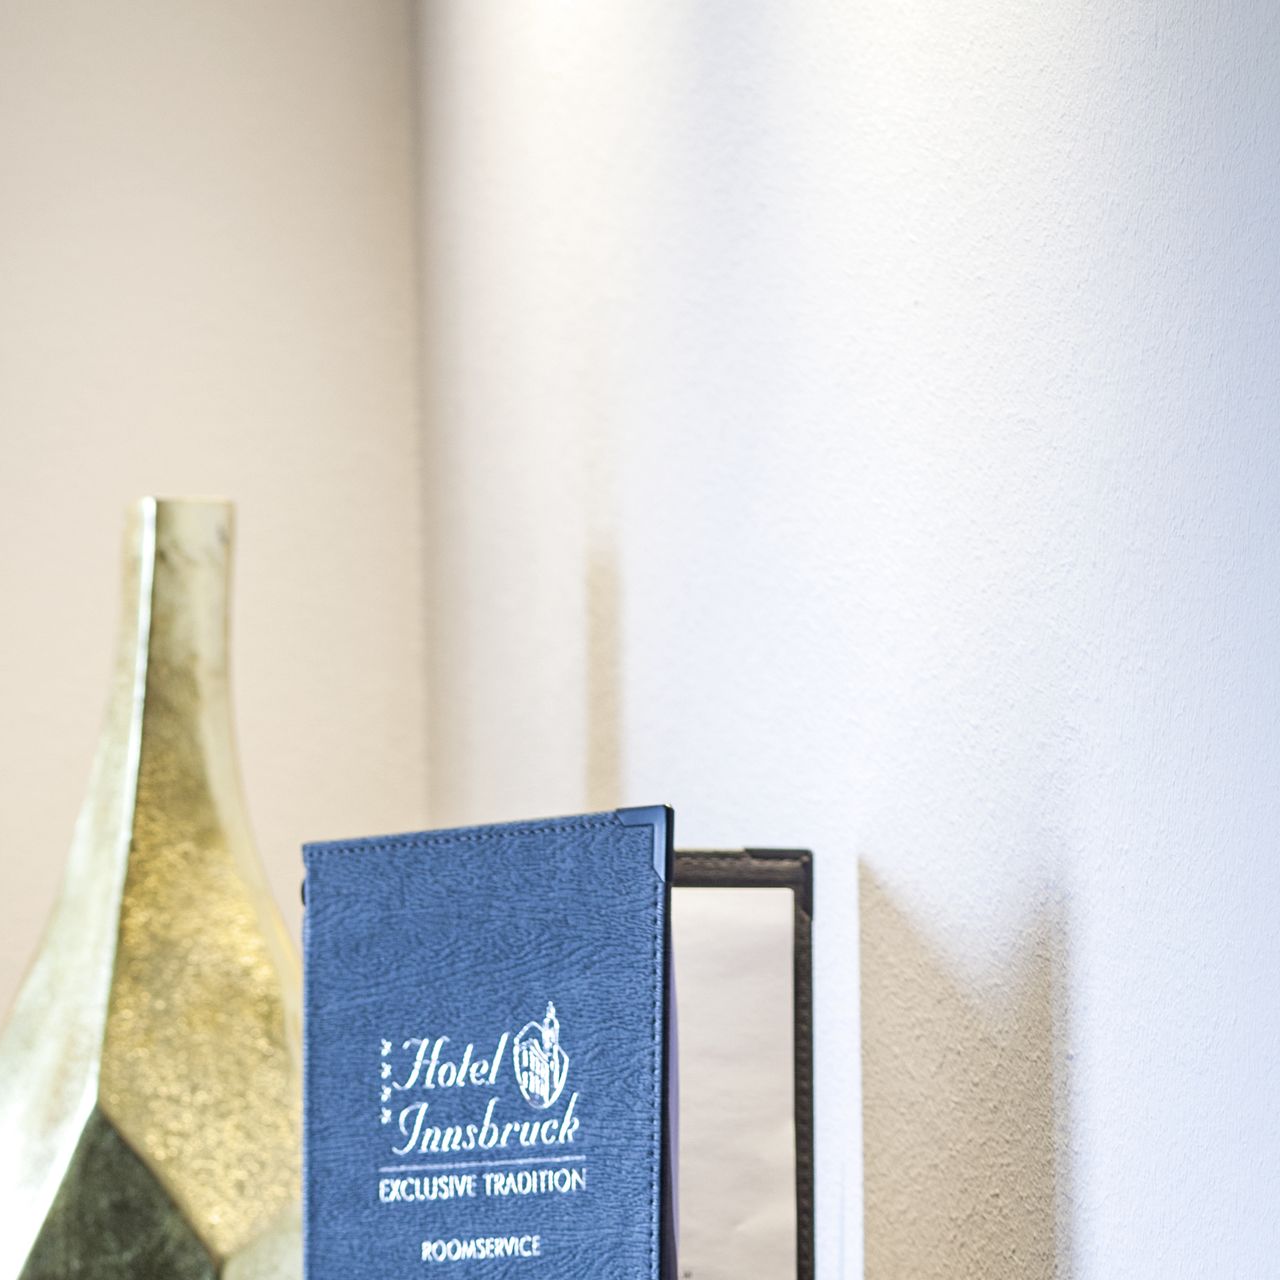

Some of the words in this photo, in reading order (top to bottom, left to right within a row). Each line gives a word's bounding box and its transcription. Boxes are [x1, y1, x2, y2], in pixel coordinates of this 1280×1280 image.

[392, 1033, 510, 1090] Hotel
[392, 1092, 580, 1155] Innsbruck
[379, 1175, 476, 1202] EXCLUSIVE
[483, 1168, 587, 1195] TRADITION
[421, 1235, 541, 1261] ROOMSERVICE
